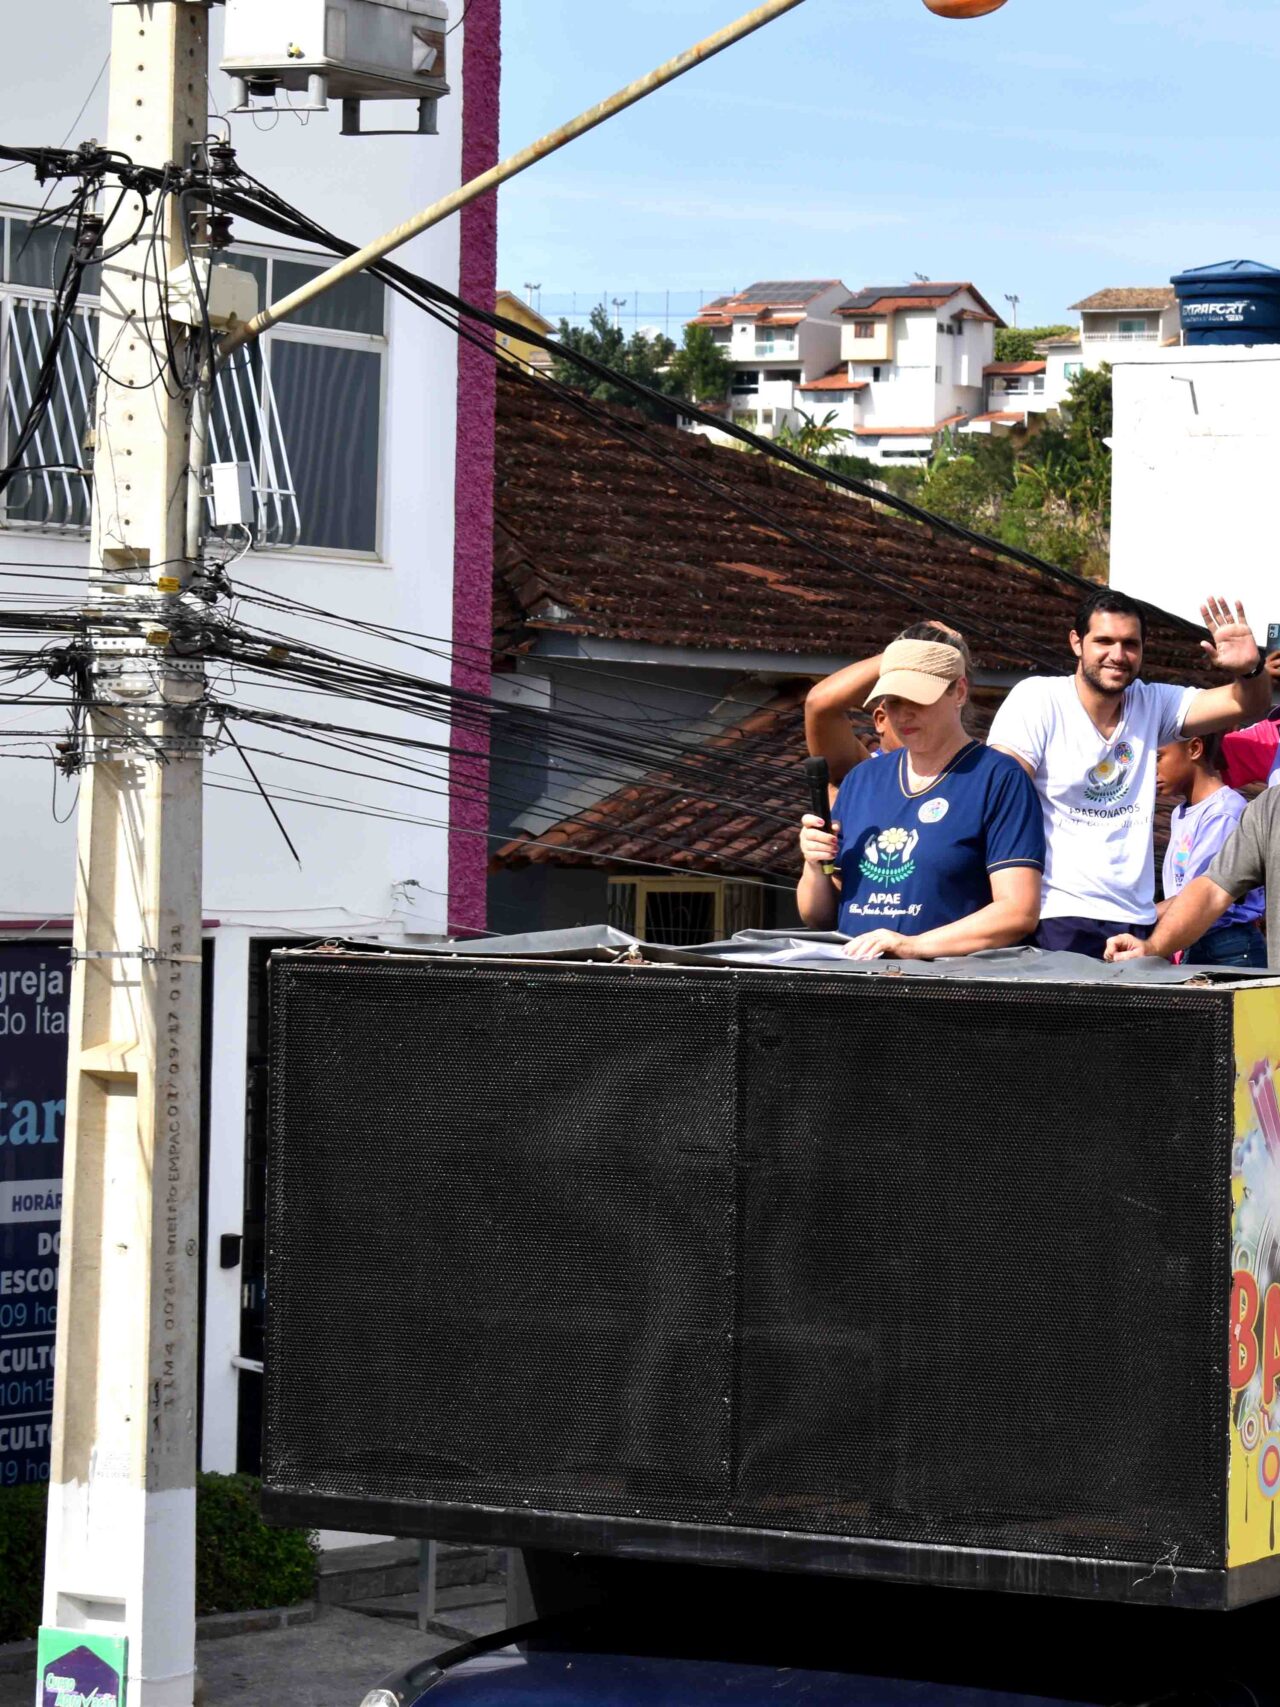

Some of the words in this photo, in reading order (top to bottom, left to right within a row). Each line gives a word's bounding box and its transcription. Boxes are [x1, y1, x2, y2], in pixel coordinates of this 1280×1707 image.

[868, 893, 901, 904] APAE
[36, 1005, 69, 1035] Ita
[0, 1303, 27, 1328] 09
[0, 1424, 52, 1452] CULT
